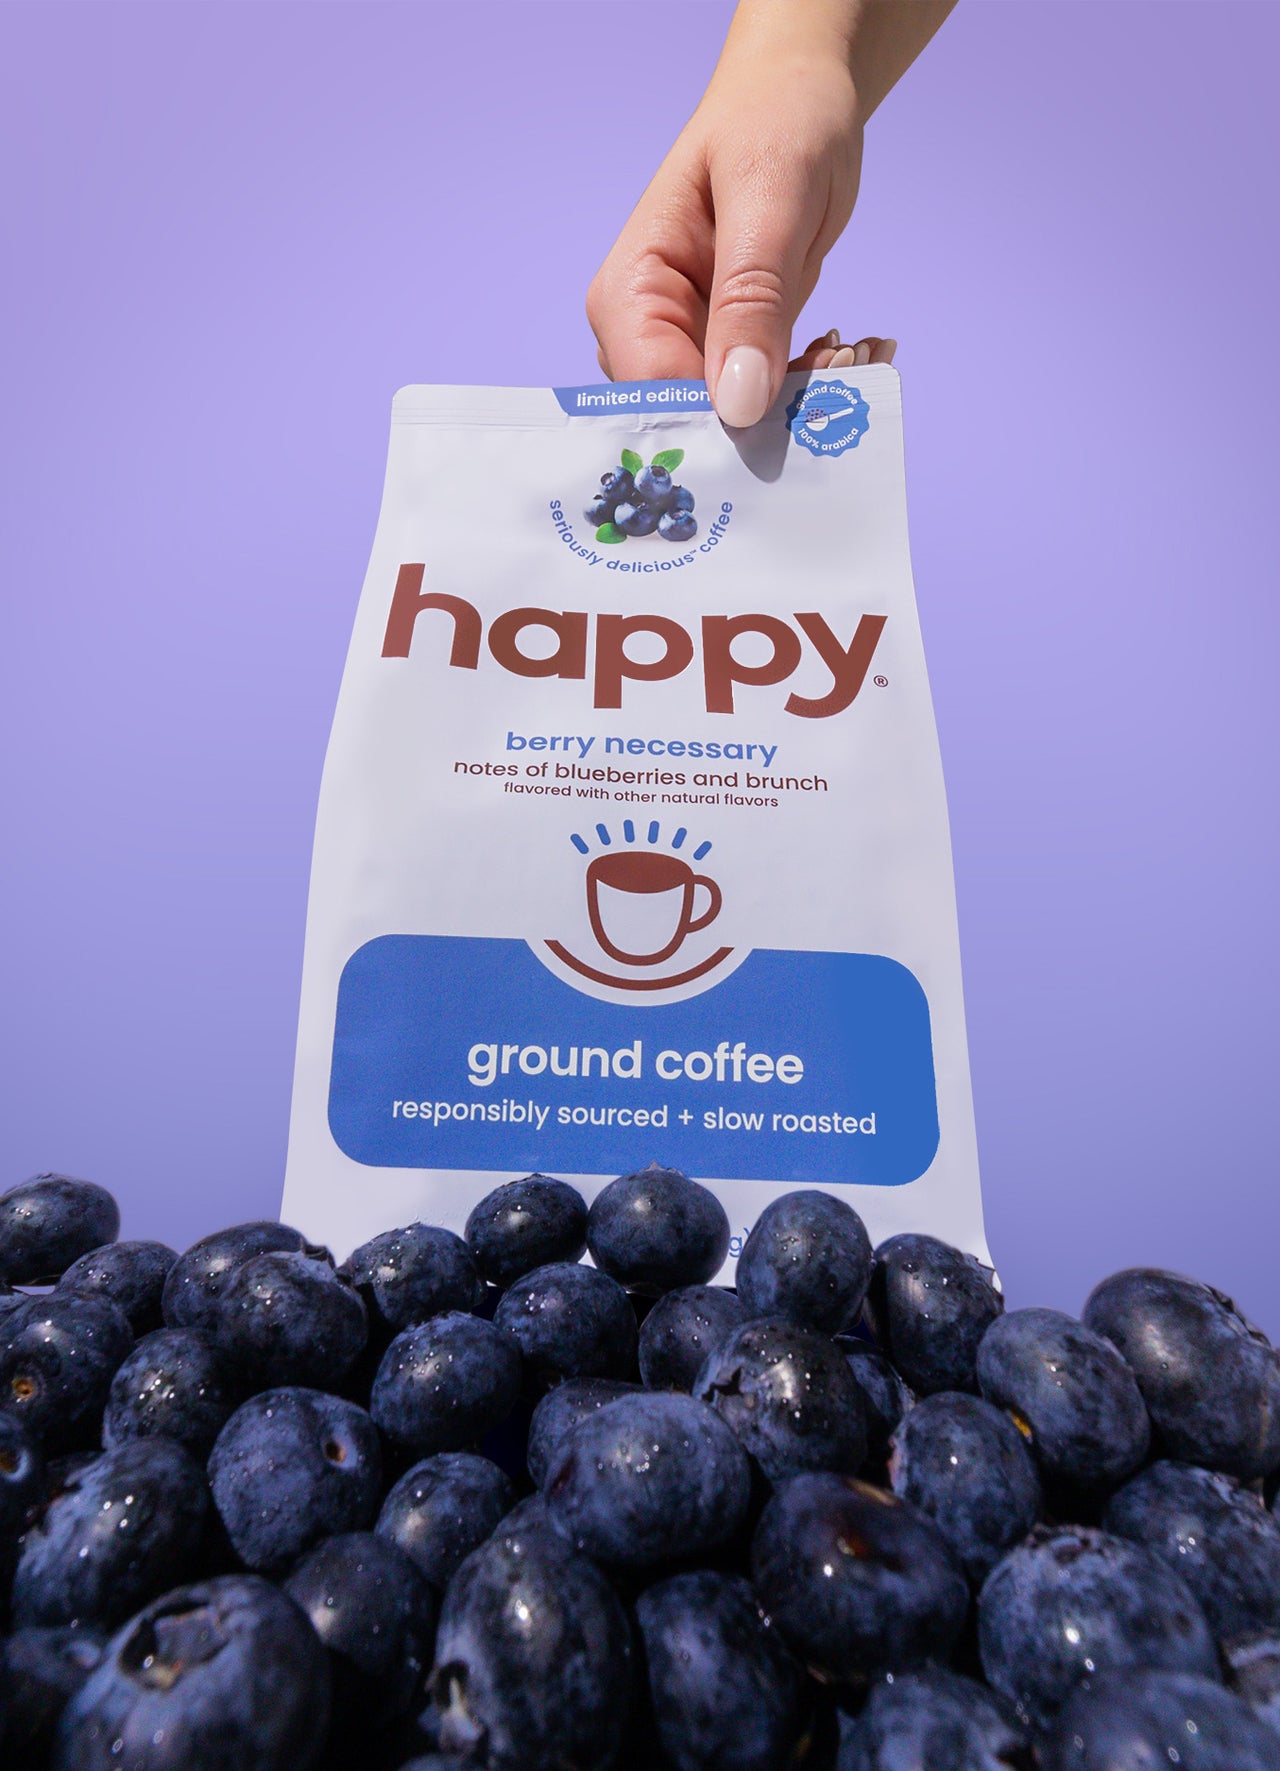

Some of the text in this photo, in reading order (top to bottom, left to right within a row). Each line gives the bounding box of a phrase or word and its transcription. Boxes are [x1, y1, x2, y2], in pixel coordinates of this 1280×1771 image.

[576, 387, 711, 407] limited edition
[829, 386, 858, 405] coffee
[797, 427, 859, 451] 100% arabica
[549, 499, 604, 567] seriously
[699, 501, 733, 553] coffee
[505, 731, 778, 768] berry necessary
[454, 760, 828, 792] notes of blueberries and brunch
[504, 781, 779, 808] flavored with other natural flavors
[467, 1040, 804, 1087] ground coffee
[392, 1098, 876, 1135] responsibly sourced + slow roasted
